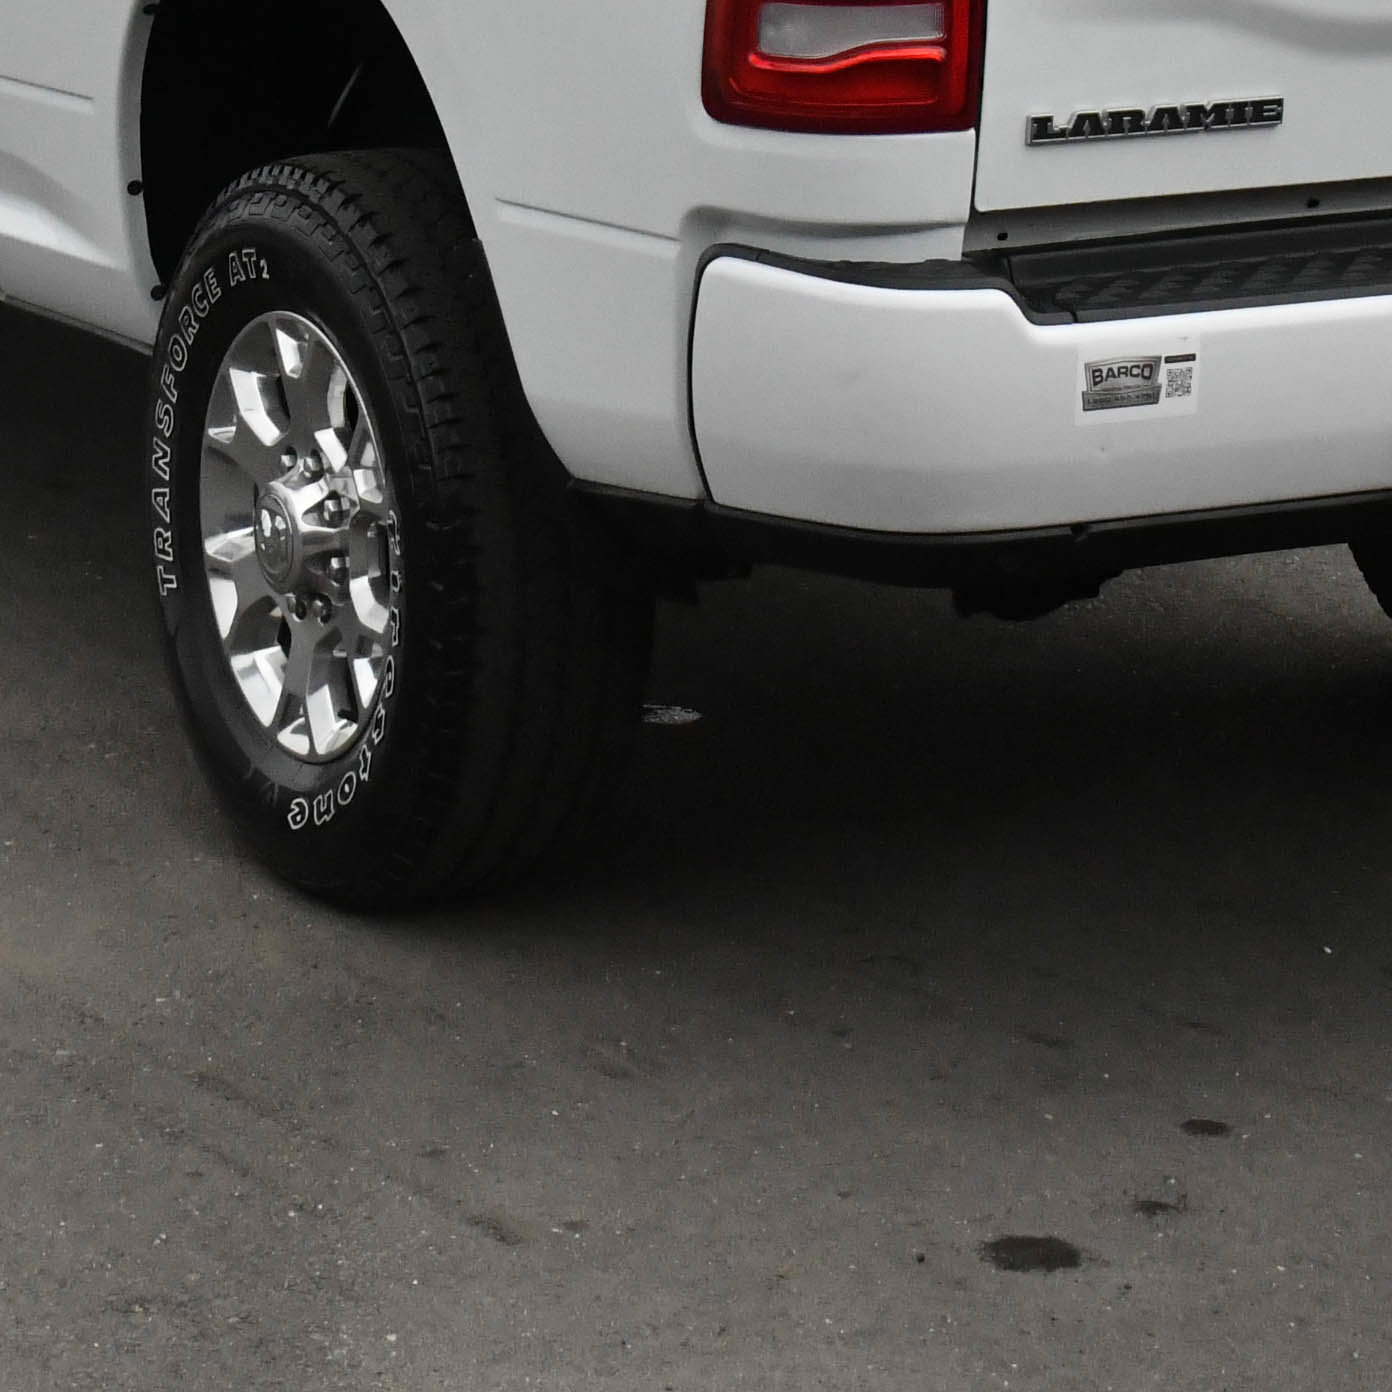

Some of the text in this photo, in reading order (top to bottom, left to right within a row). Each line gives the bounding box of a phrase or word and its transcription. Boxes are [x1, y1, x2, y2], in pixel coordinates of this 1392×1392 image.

[1025, 95, 1284, 146] LARAMIE
[1091, 363, 1154, 387] BARCO
[152, 267, 222, 596] TRANSFORCE
